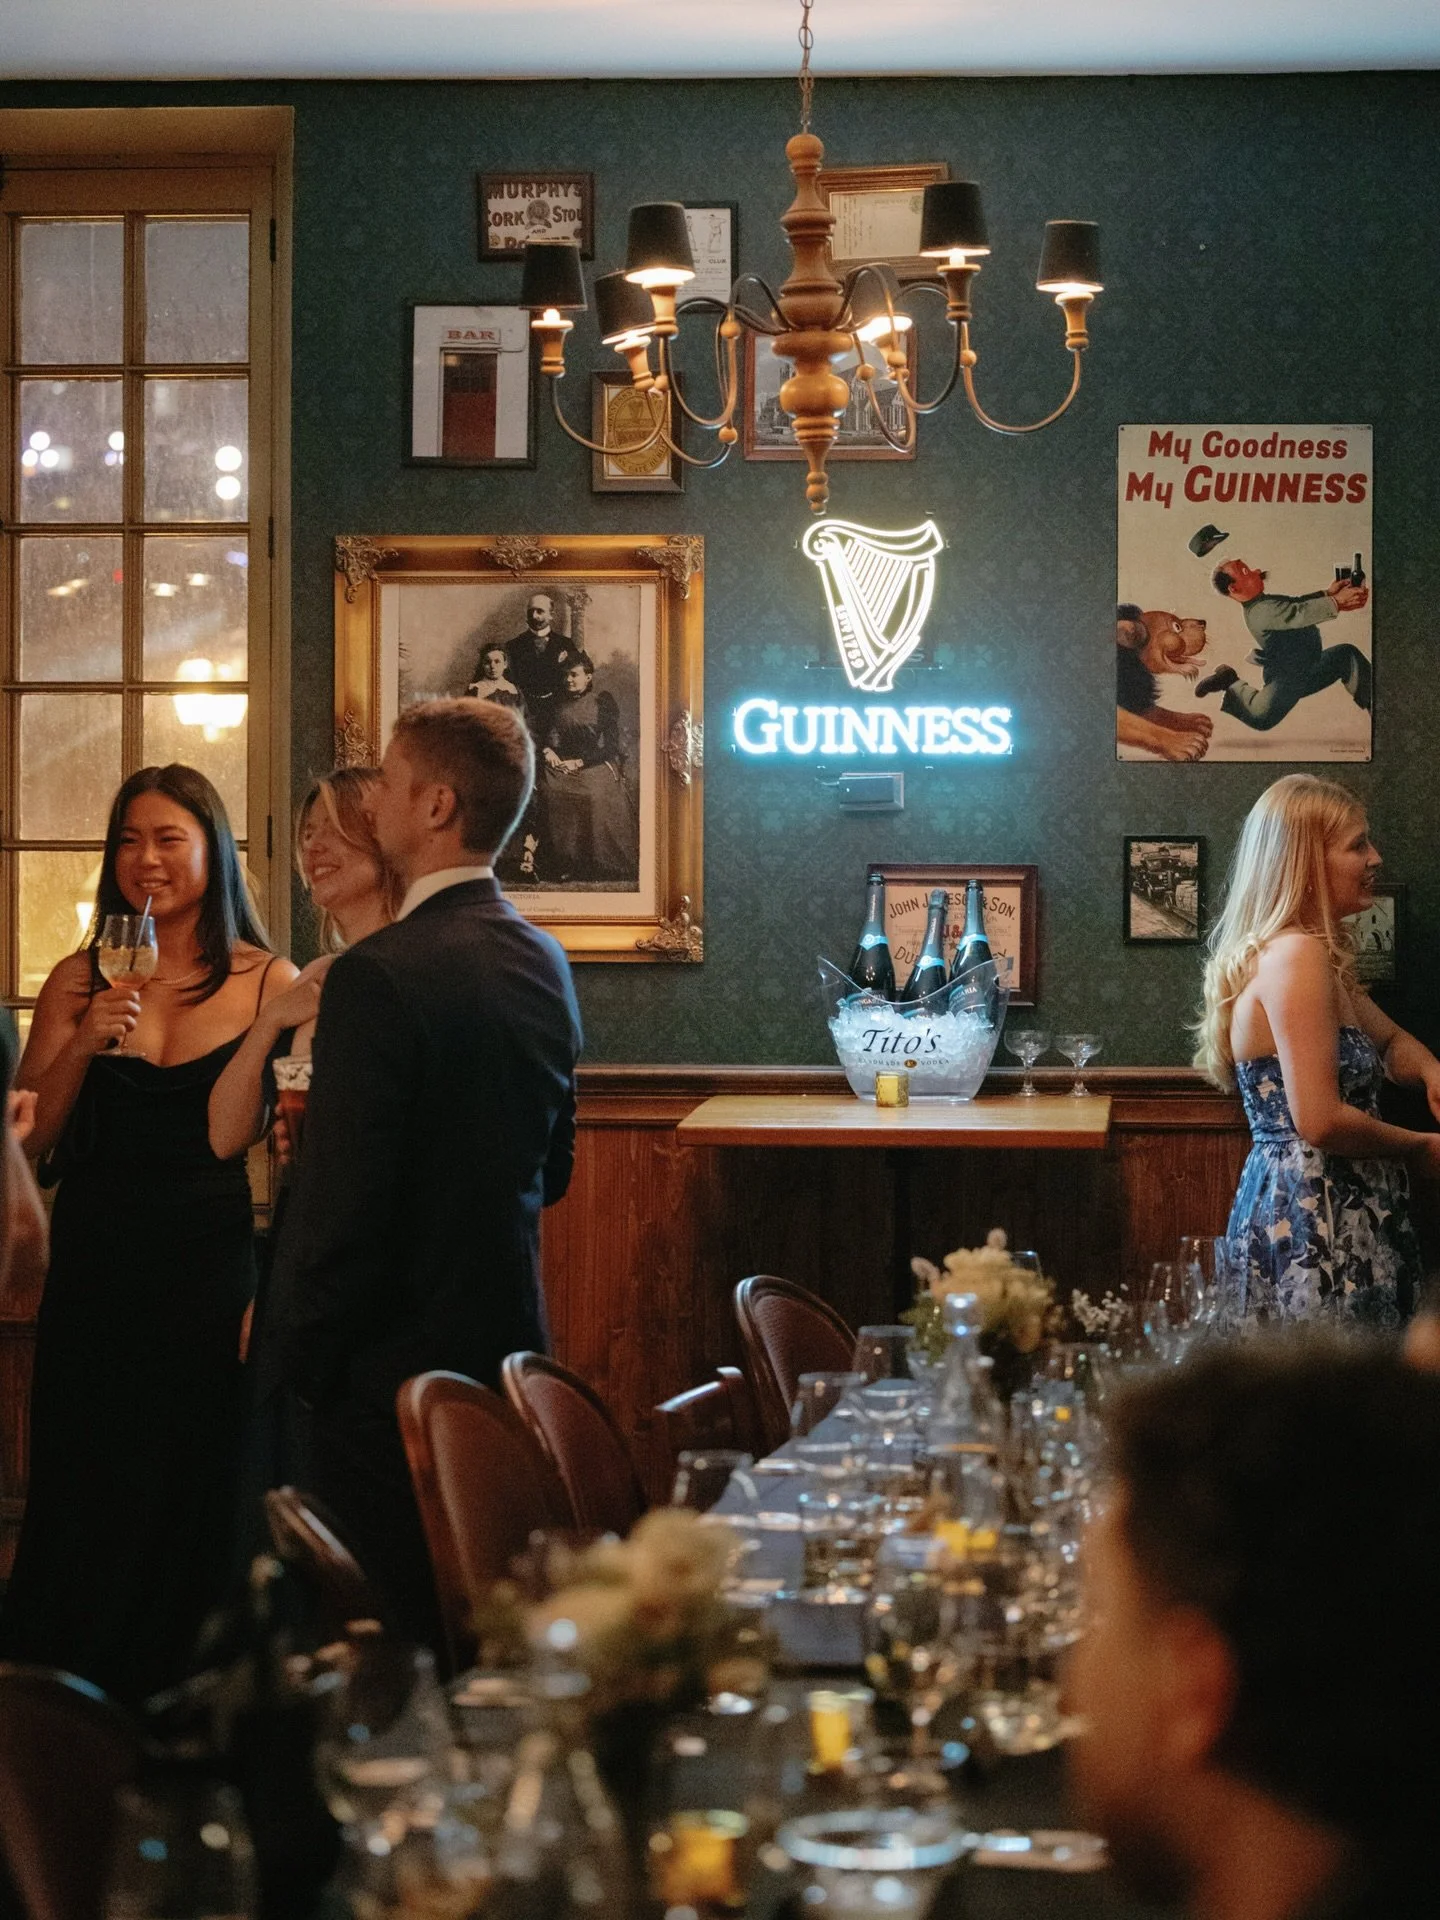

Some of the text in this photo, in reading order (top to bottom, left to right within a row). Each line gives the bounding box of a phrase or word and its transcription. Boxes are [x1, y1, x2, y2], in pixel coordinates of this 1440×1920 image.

[447, 330, 495, 340] BAR
[1148, 431, 1348, 464] My Goodness
[1126, 465, 1368, 508] My GUINNESS
[734, 699, 1011, 754] GUINNESS
[890, 898, 919, 919] JOHN
[862, 1028, 941, 1055] Tito's
